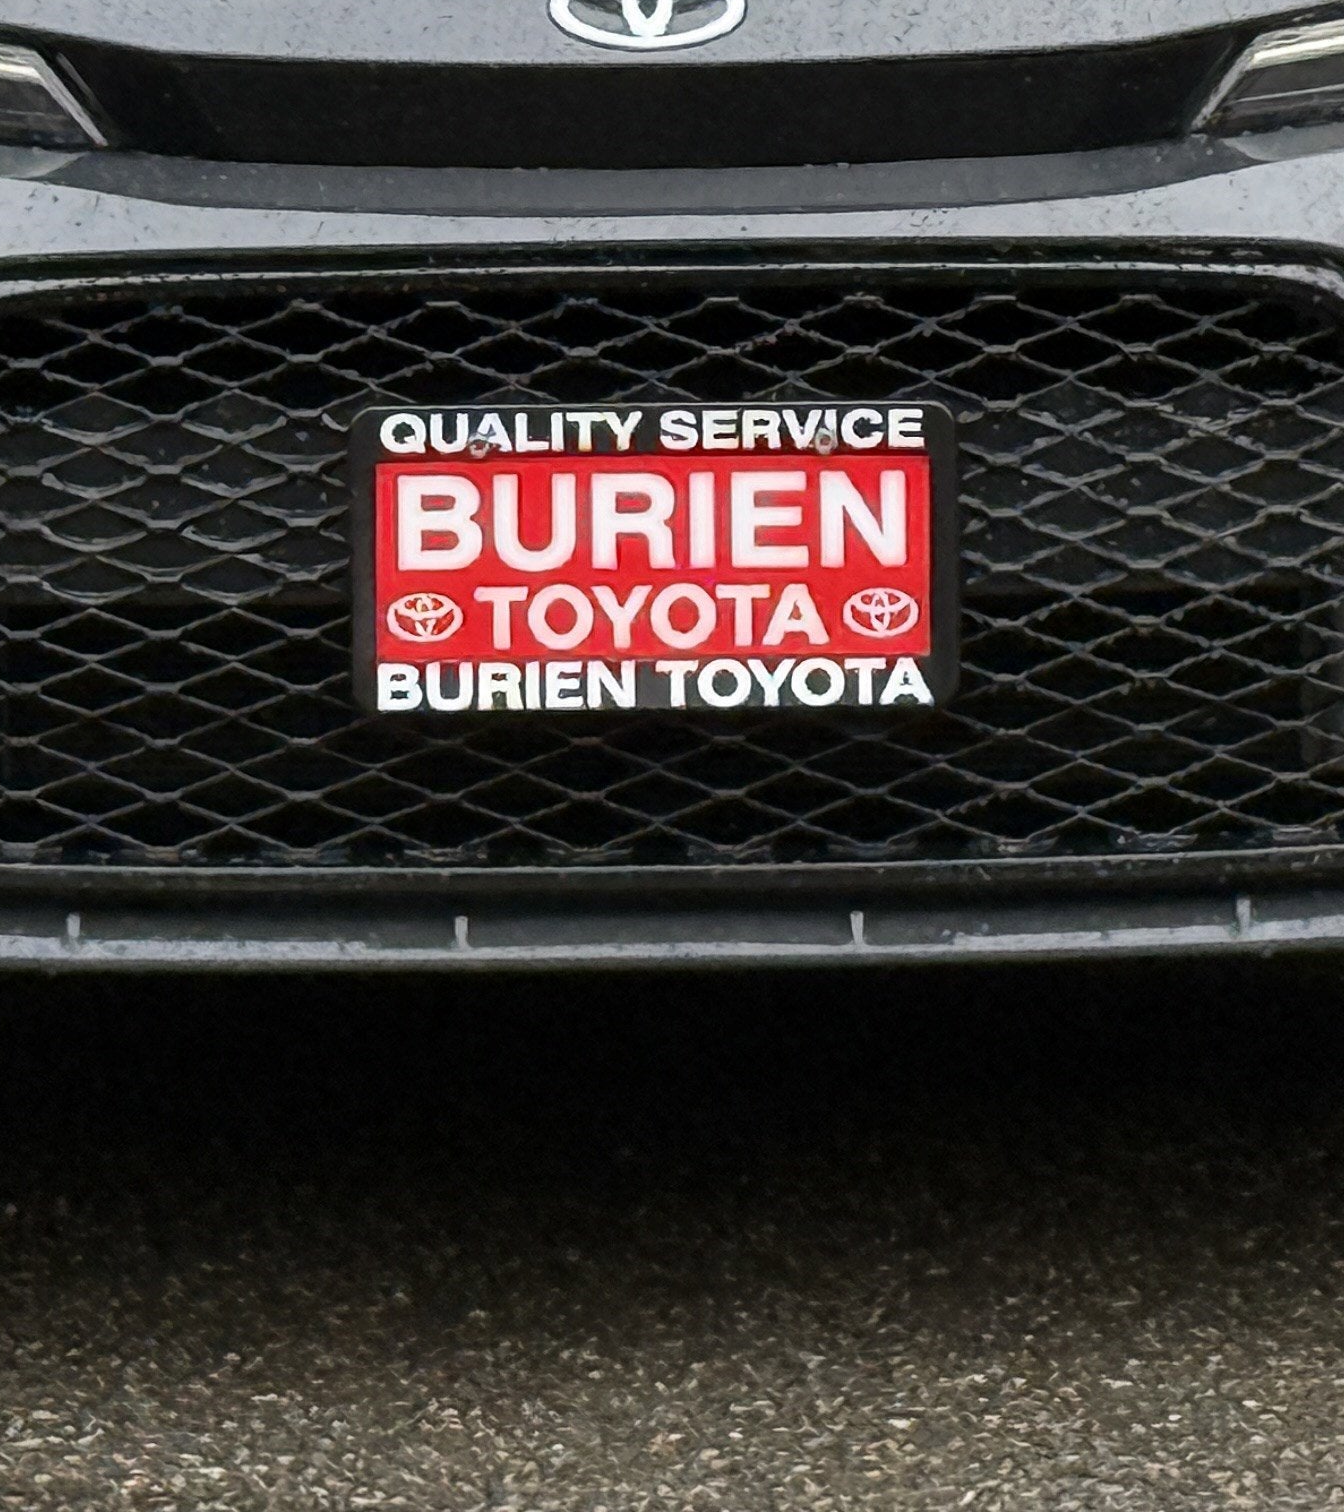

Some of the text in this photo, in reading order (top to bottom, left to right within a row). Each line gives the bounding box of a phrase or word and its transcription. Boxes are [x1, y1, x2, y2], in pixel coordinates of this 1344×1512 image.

[379, 408, 925, 455] QUALITY SERVICE
[397, 470, 907, 572] BURIEN
[474, 583, 829, 650] TOYOTA
[377, 657, 933, 712] BURIEN TOYOTA
